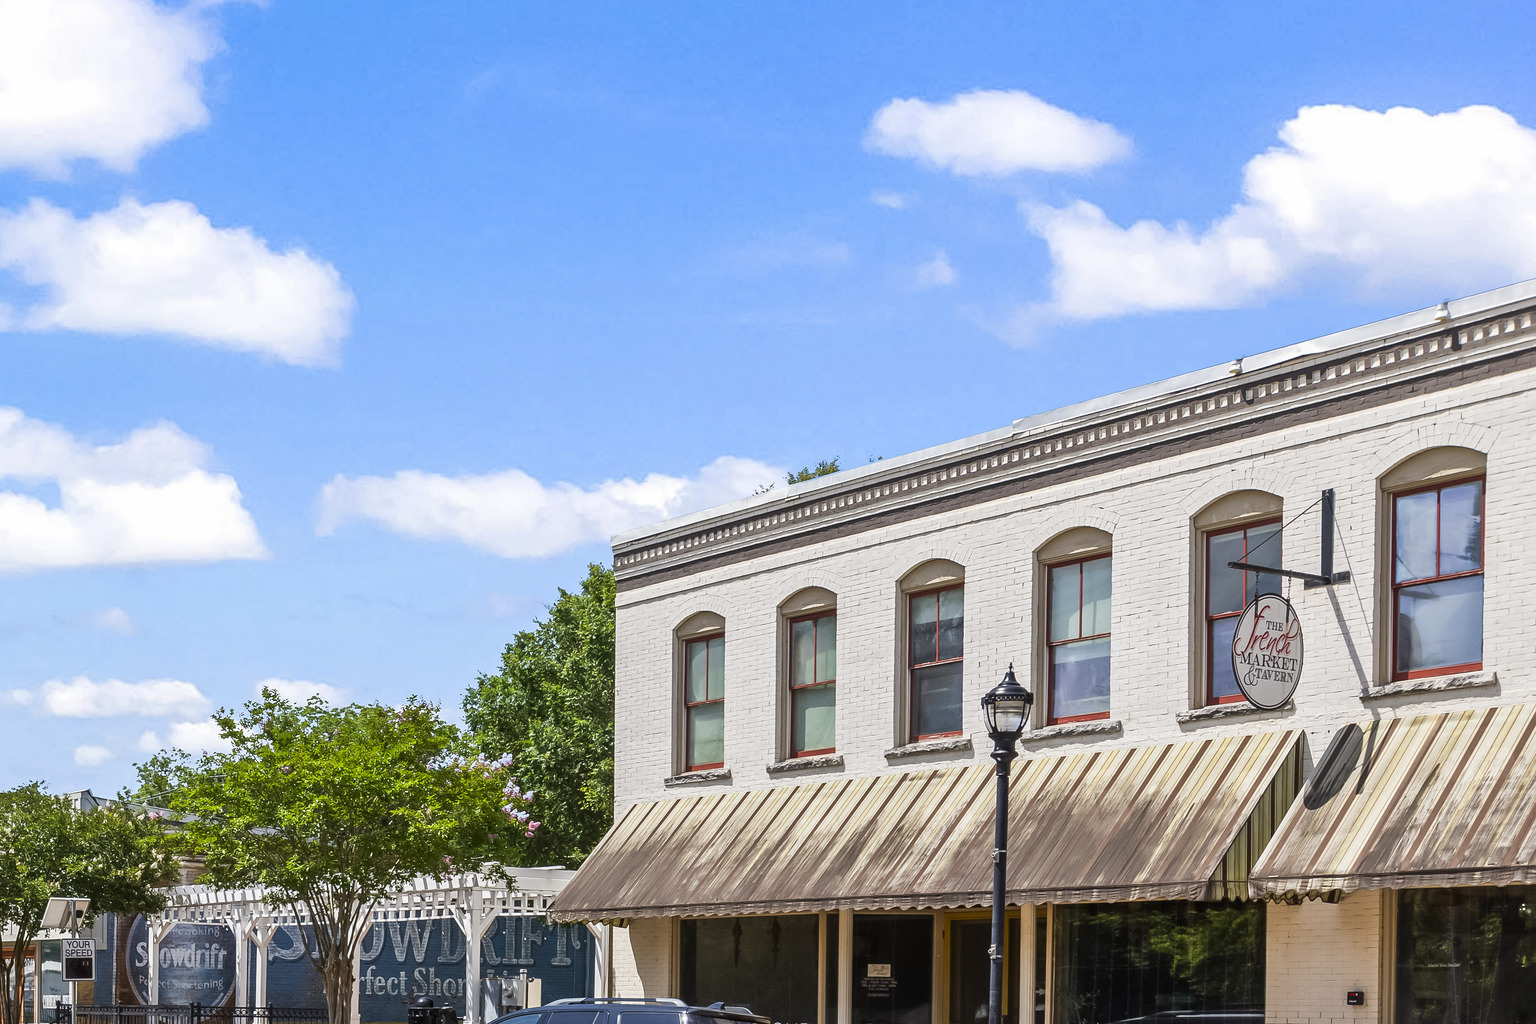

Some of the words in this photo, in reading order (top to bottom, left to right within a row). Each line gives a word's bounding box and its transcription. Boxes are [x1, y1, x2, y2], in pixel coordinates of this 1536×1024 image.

[1265, 620, 1284, 632] THE
[1240, 651, 1298, 672] MARKET
[1244, 665, 1259, 686] &
[1255, 668, 1294, 683] TAVERN
[66, 940, 91, 949] YOUR
[65, 949, 93, 957] SPEED
[135, 941, 227, 969] Sowdrift
